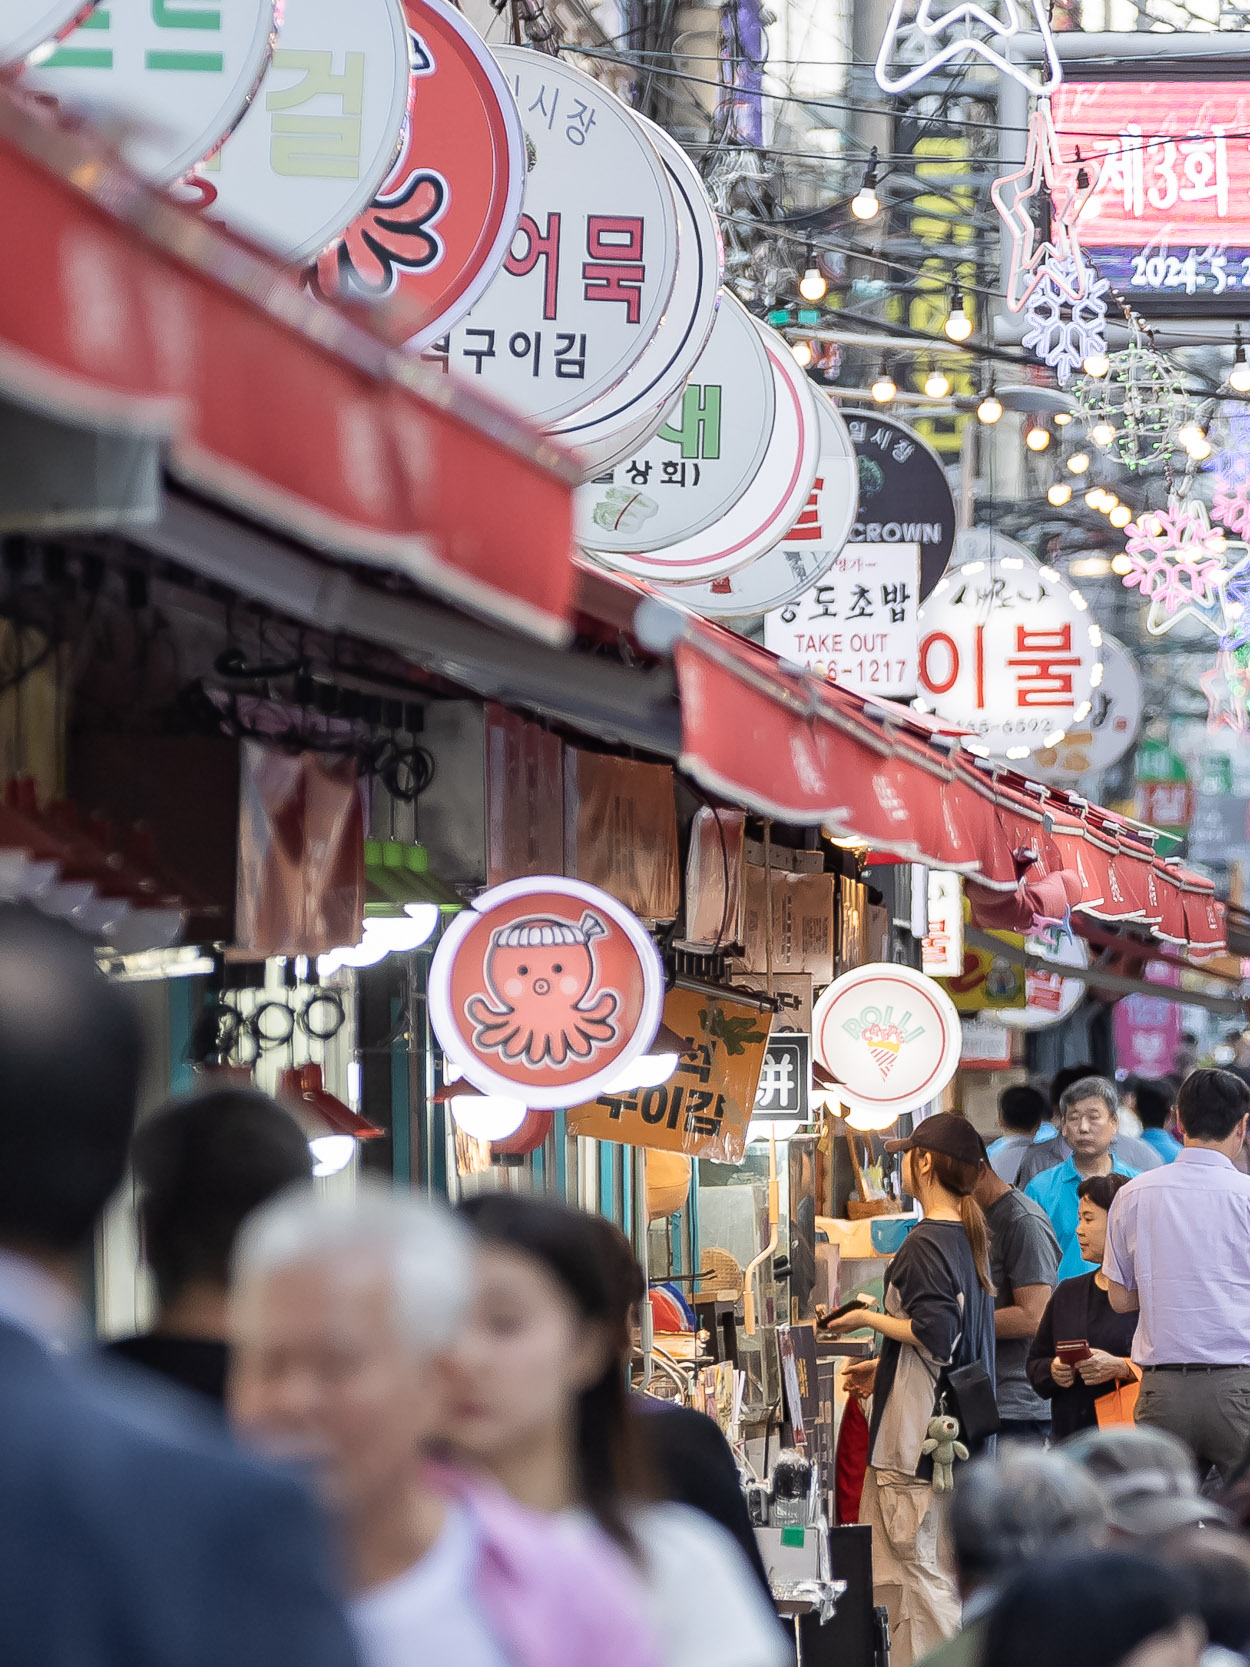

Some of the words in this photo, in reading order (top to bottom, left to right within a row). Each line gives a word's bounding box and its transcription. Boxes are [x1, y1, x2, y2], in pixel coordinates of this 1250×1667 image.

[514, 74, 597, 147] 시장
[1092, 122, 1231, 219] 제3회
[503, 211, 647, 325] 어묵
[848, 522, 943, 545] CROWN
[794, 633, 843, 653] TAKE
[850, 633, 889, 653] OUT
[919, 622, 1083, 710] 이불
[957, 718, 1054, 734] 65-6592
[841, 1005, 927, 1044] ROLLI
